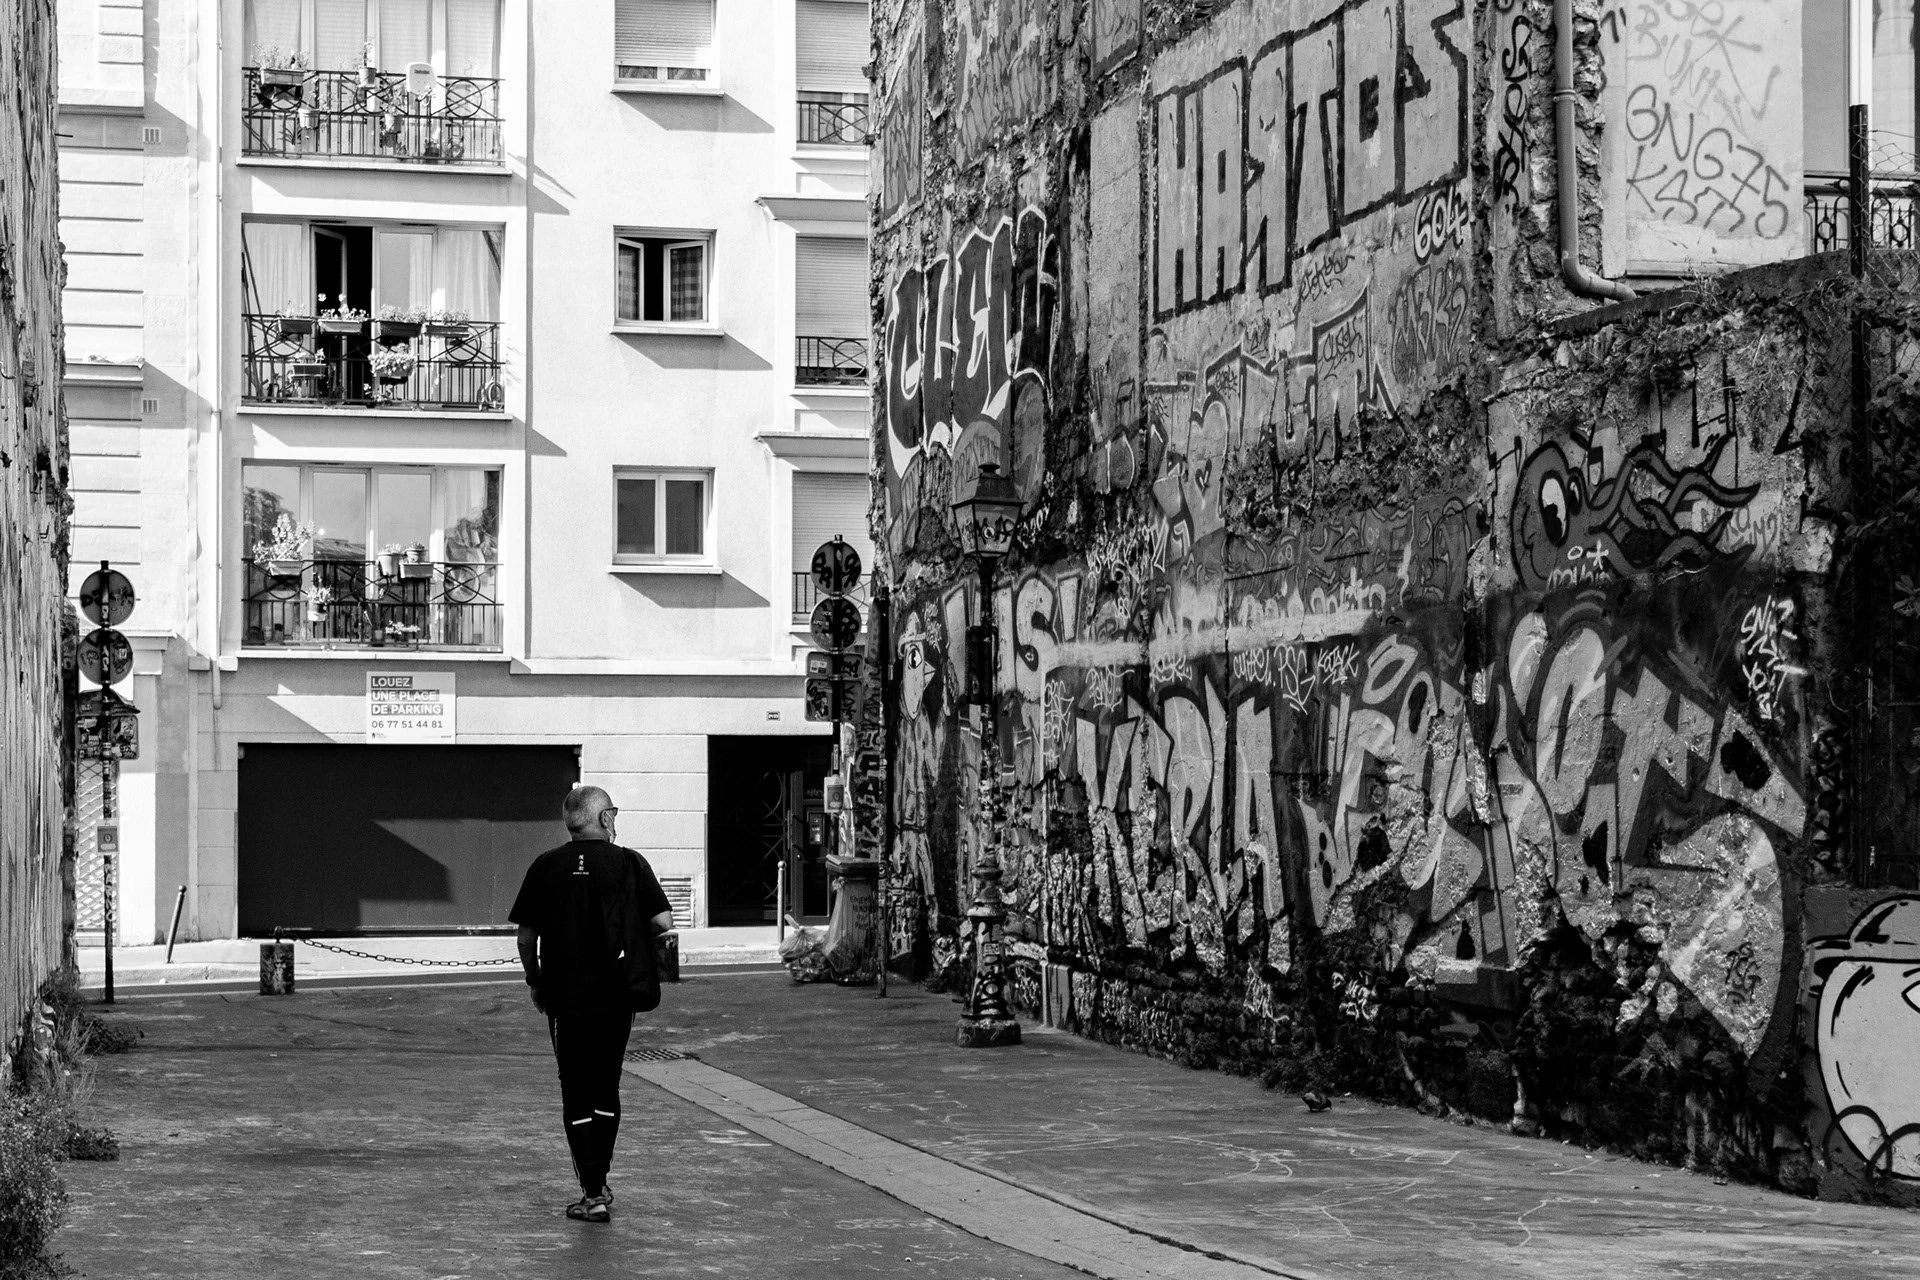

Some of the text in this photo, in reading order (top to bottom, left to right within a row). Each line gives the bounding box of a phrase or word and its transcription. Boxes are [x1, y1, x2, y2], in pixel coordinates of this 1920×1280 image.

[372, 677, 410, 687] LOUEZ
[372, 691, 437, 701] UNE PLACE
[372, 704, 441, 715] DE PARKING
[371, 720, 443, 728] 06 77 51 44 81
